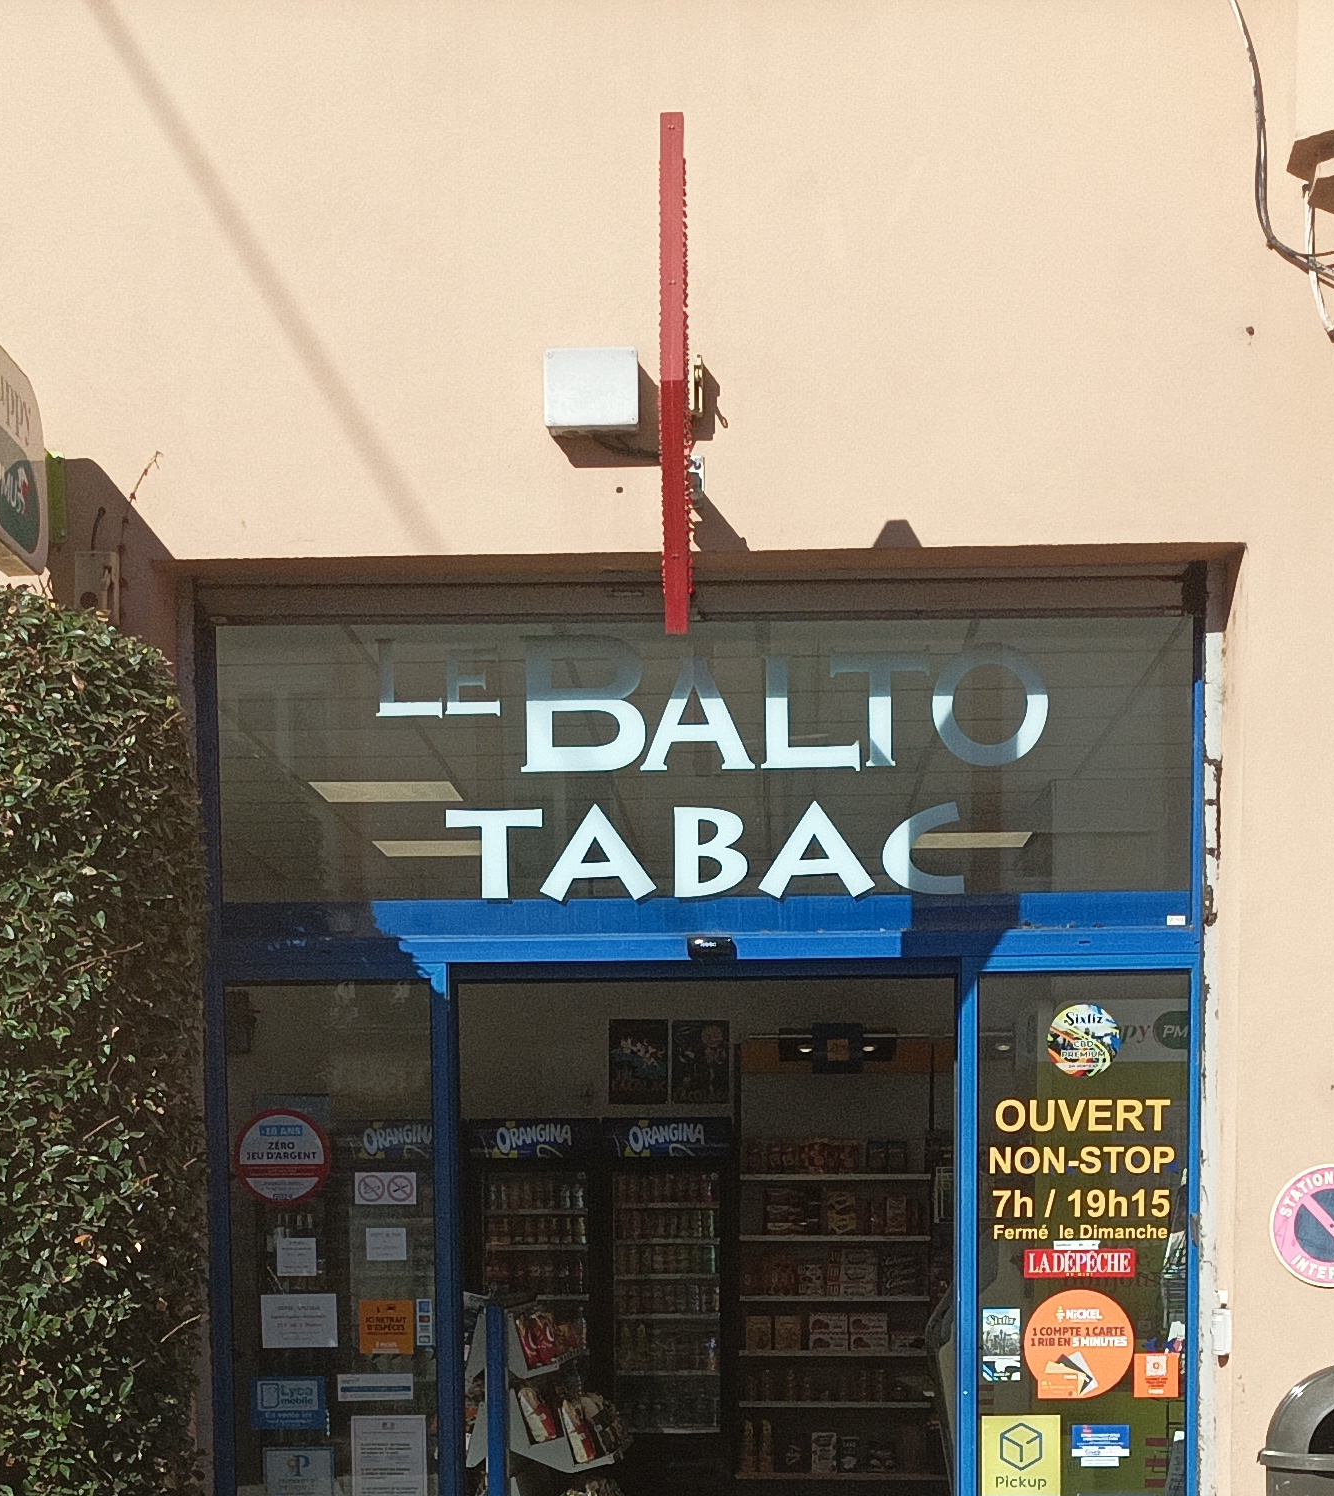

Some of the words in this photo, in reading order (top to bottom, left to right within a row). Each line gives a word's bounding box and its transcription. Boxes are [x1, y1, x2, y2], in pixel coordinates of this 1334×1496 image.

[375, 637, 502, 719] LE
[520, 634, 1050, 773] BALTO
[444, 800, 967, 902] TABAC
[1061, 1050, 1106, 1058] PREMIUM
[1073, 1040, 1094, 1048] CBD
[994, 1099, 1171, 1133] OUVERT
[267, 1140, 296, 1151] ZÉRO
[496, 1123, 572, 1153] ORANGINA
[628, 1122, 705, 1153] ORANGINA
[246, 1151, 265, 1161] JEU
[266, 1151, 317, 1161] D'ARGENT
[988, 1146, 1175, 1174] NON-STOP
[992, 1188, 1034, 1218] 7h
[1043, 1188, 1057, 1219] /
[1067, 1188, 1171, 1218] 19h15
[992, 1222, 1049, 1240] Fermé
[1058, 1223, 1075, 1240] le
[1079, 1223, 1169, 1240] Dimanche
[1028, 1252, 1051, 1273] LA
[1052, 1250, 1132, 1273] DÉPÊCHE
[1030, 1337, 1037, 1347] 1
[1038, 1337, 1056, 1347] RIB
[1057, 1337, 1071, 1347] EN
[1072, 1336, 1080, 1347] 5
[1080, 1336, 1128, 1347] MINUTES
[1032, 1326, 1038, 1337] 1
[1039, 1326, 1082, 1337] COMPTE
[1085, 1326, 1091, 1337] 1
[1092, 1326, 1126, 1337] CARTE
[995, 1475, 1048, 1491] Pickup
